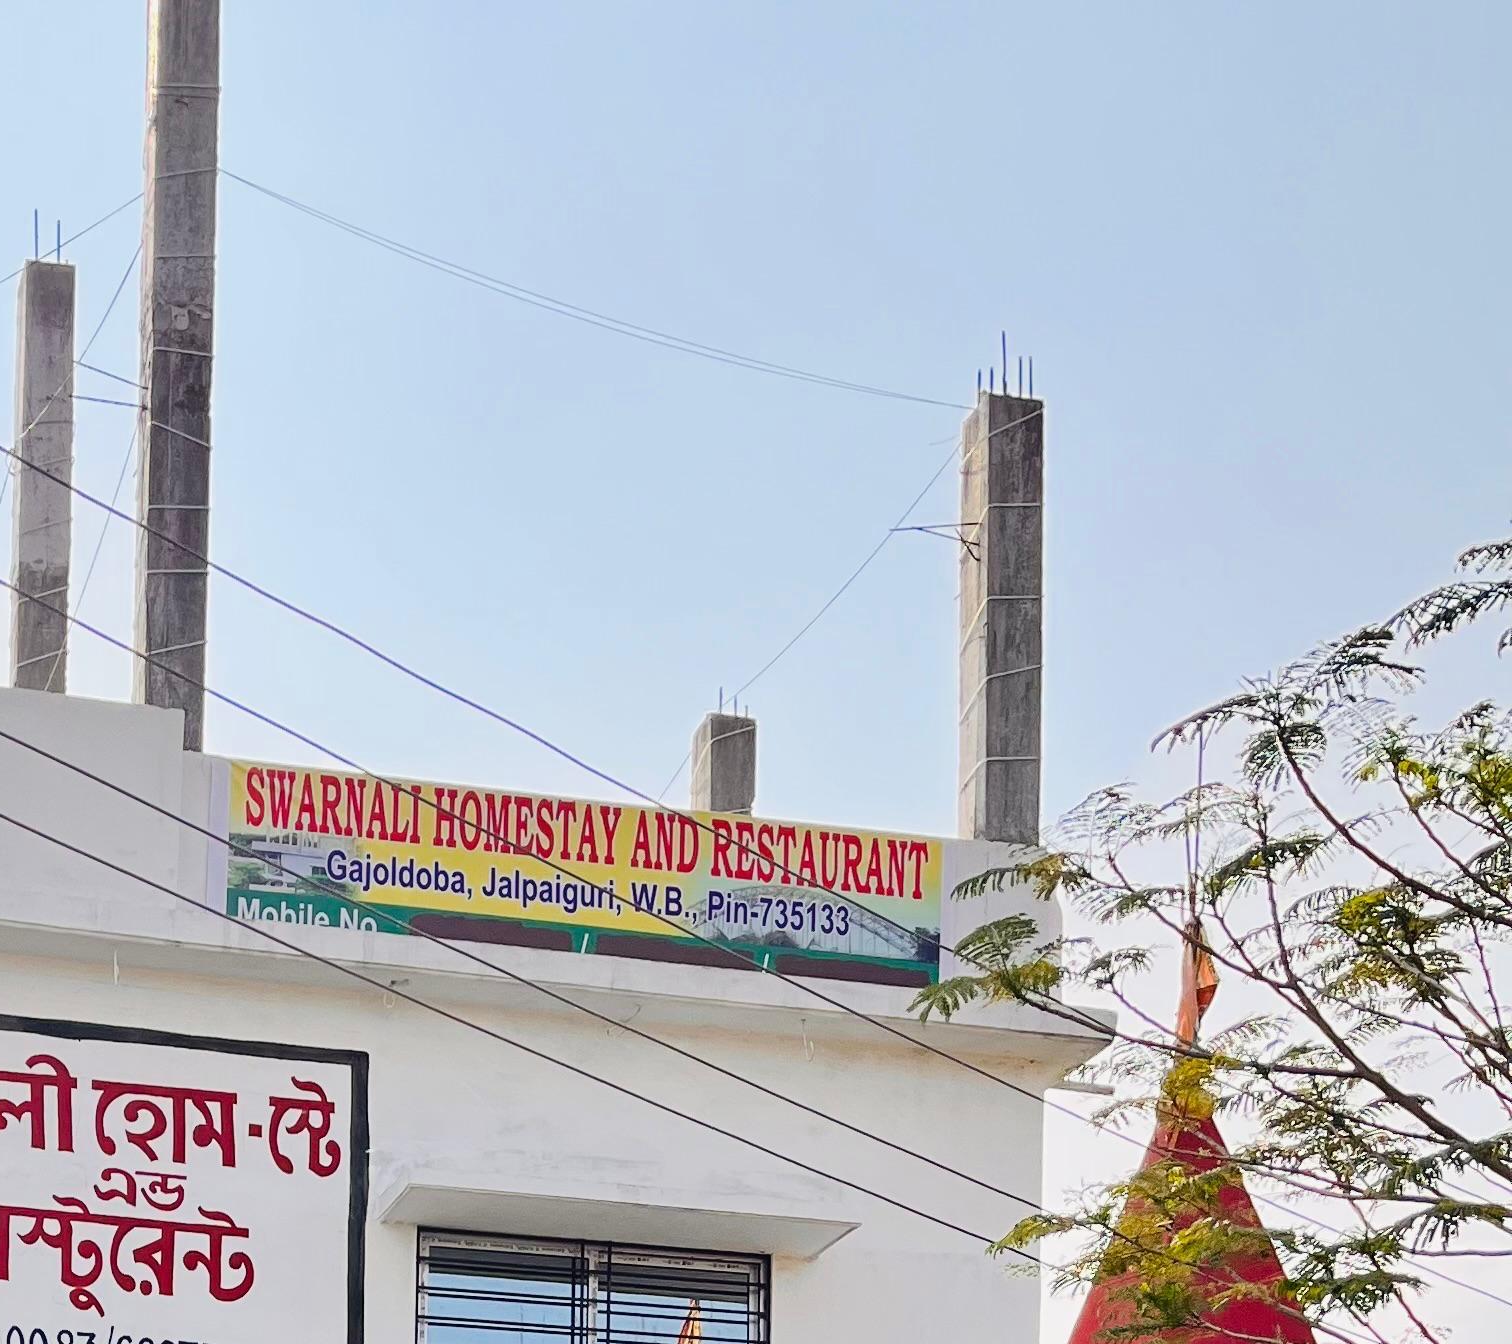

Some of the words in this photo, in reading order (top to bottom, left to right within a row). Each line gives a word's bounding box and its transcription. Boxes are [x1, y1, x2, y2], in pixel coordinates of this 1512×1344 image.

[246, 767, 421, 844] SWARNALI
[433, 787, 621, 865] HOMESTAY
[631, 809, 699, 873] AND
[711, 819, 928, 899] RESTAURANT
[238, 897, 330, 926] Mobile
[327, 850, 472, 899] Gajoldoba,
[482, 868, 621, 915] Jalpaiguri,
[632, 882, 697, 923] W.B.,
[708, 891, 849, 935] Pin-735133
[94, 1168, 187, 1211] এন্ড
